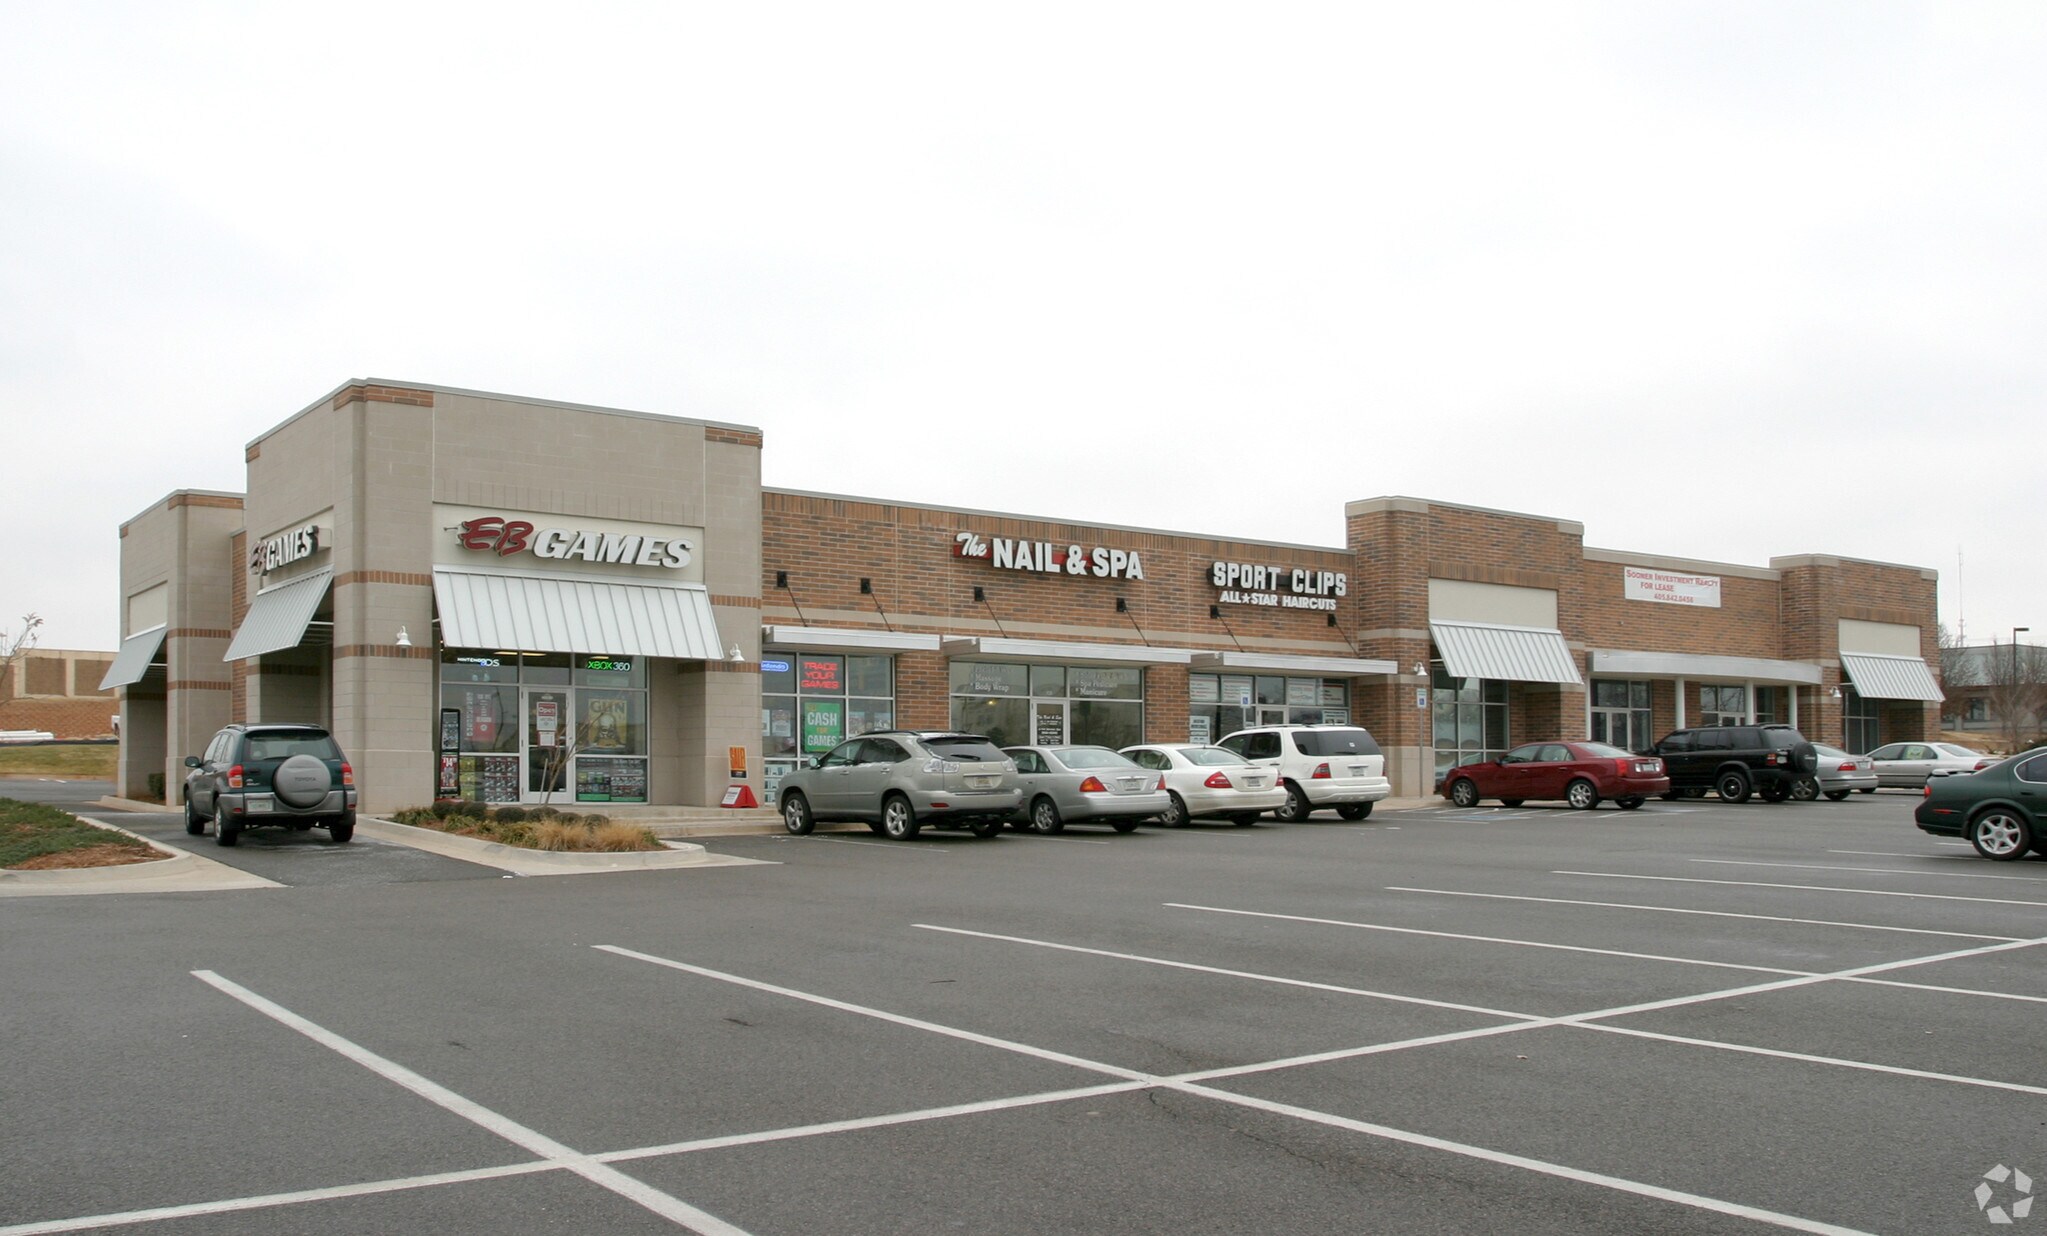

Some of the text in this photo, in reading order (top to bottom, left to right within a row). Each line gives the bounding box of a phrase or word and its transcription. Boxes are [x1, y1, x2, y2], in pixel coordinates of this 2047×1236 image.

[266, 524, 316, 571] GAMES
[463, 516, 695, 570] EB GAMES
[956, 532, 1144, 580] The NAIL & SPA
[1213, 561, 1347, 597] SPORT CLIPS
[1654, 583, 1675, 592] LEASE
[1282, 595, 1337, 610] HAIRCUTS
[612, 662, 631, 671] 360
[803, 662, 838, 671] TRADE
[805, 671, 835, 680] YOUR
[801, 680, 840, 689] GAMES
[807, 712, 837, 727] CASH
[807, 735, 837, 747] GAMES
